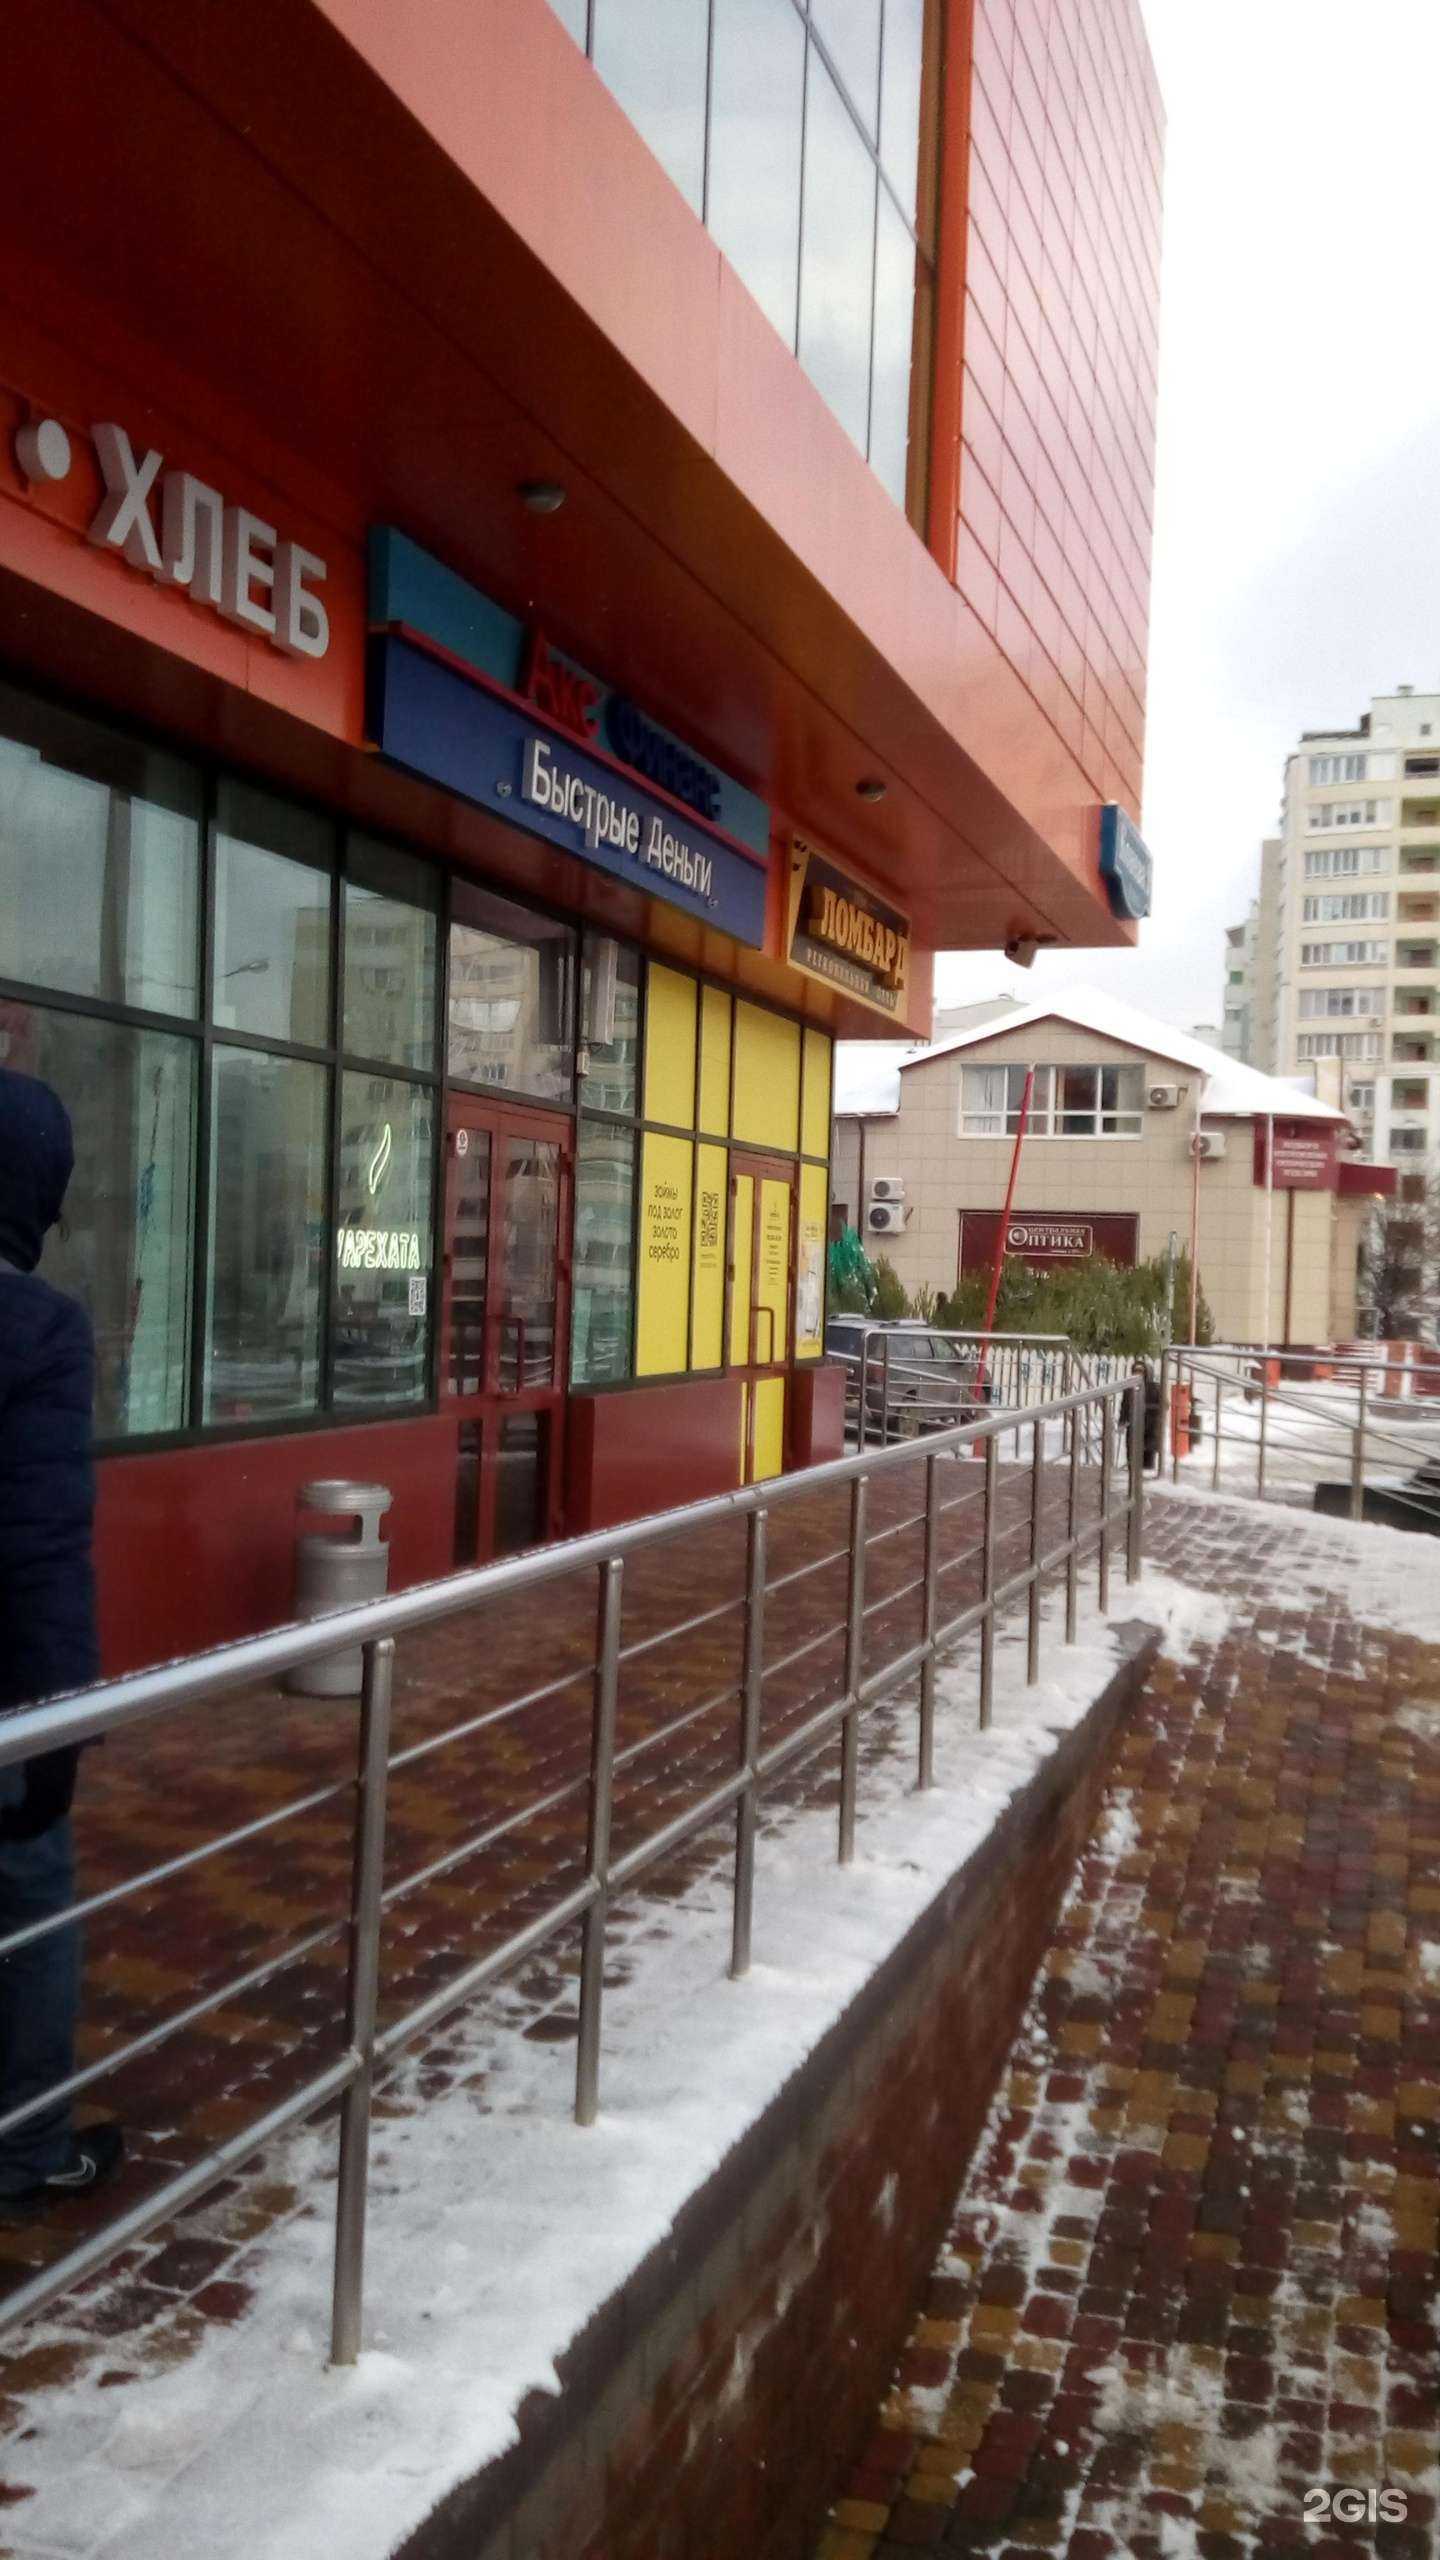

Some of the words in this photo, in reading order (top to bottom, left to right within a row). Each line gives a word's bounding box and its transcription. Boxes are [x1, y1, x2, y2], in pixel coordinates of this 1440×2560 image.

[88, 422, 330, 658] ХЛЕБ
[524, 738, 640, 854] Быстрые
[643, 815, 714, 897] Деньги
[815, 886, 905, 990] ЛОМБАРД
[649, 1242, 680, 1263] серебро
